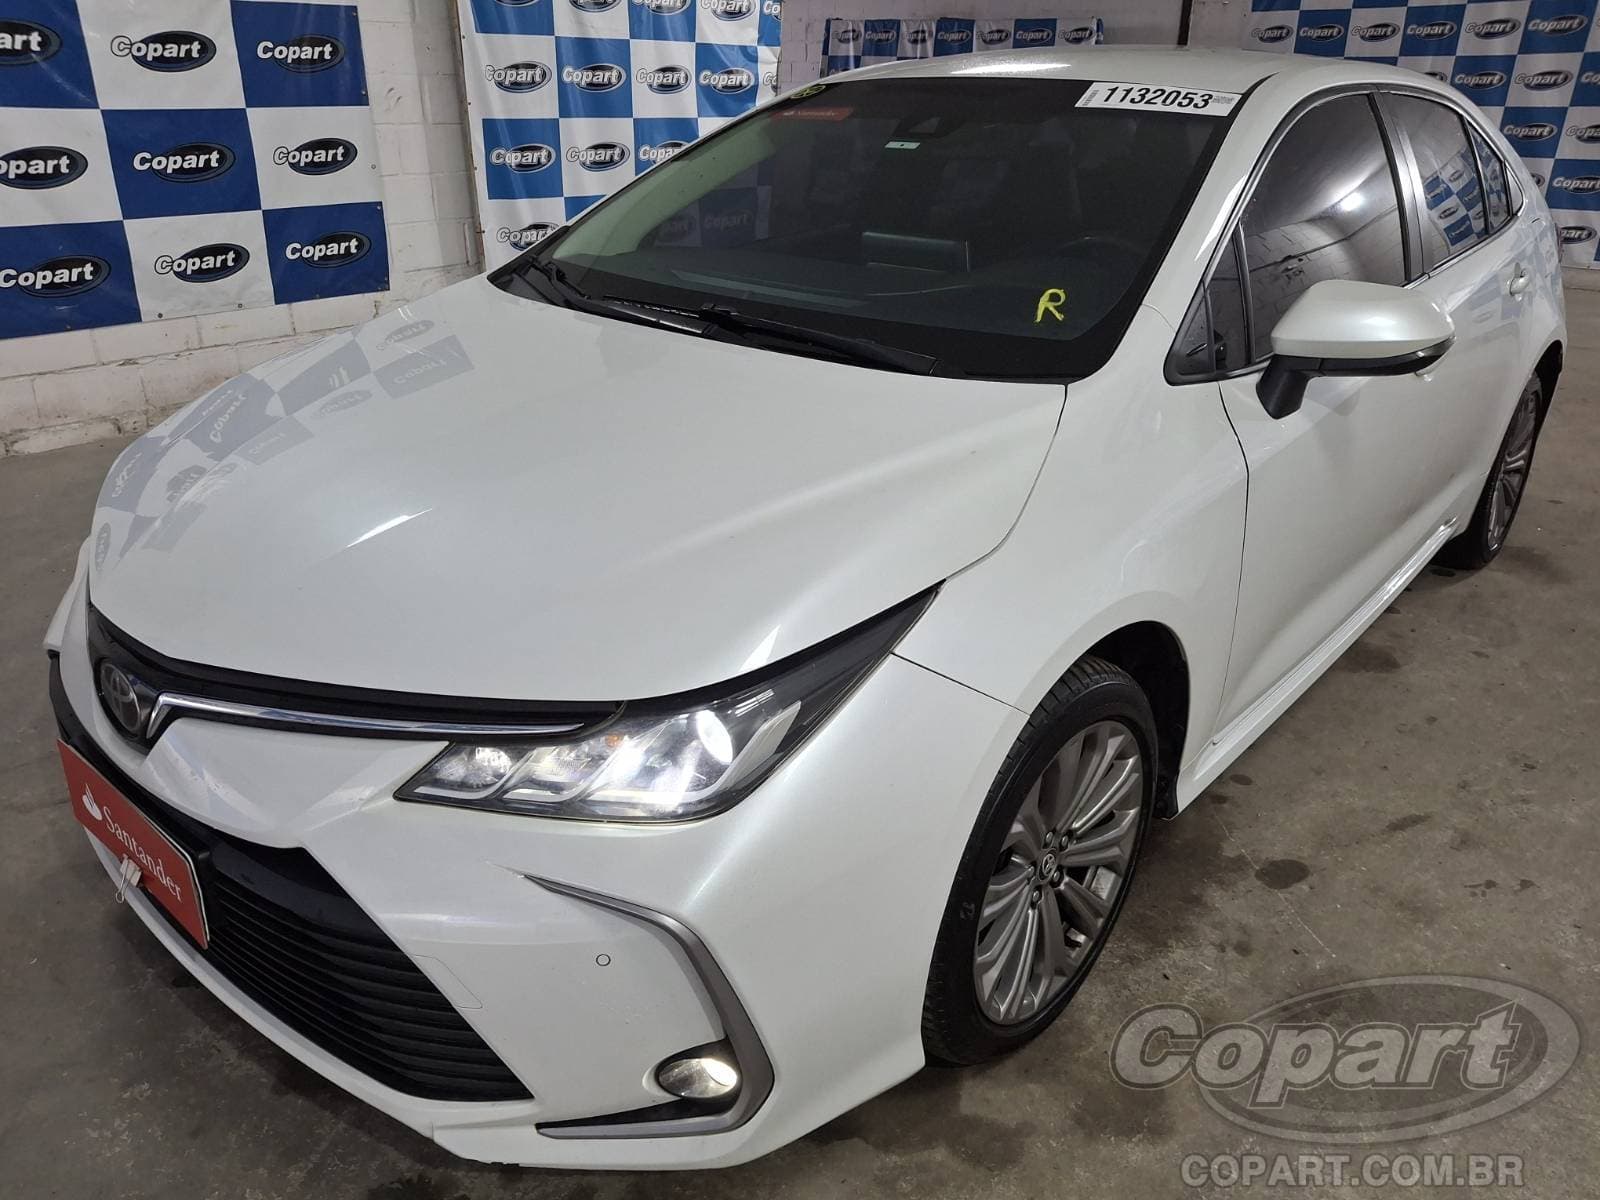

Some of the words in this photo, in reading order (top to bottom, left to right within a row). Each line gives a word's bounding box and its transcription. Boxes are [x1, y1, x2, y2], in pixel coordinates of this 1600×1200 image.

[1251, 27, 1288, 38] Copart
[1300, 26, 1339, 38] Copart
[1351, 25, 1394, 37] Copart
[1407, 24, 1450, 35] Copart
[1465, 22, 1512, 33] Copart
[1528, 18, 1580, 32] Copart
[1016, 30, 1049, 40] Copart
[111, 35, 201, 61] Copart
[257, 41, 333, 63] Copart
[485, 64, 544, 85] Copart
[562, 66, 622, 86] Copart
[636, 68, 687, 87] Copart
[700, 71, 748, 88] Copart
[1455, 73, 1500, 86] Copart
[1515, 72, 1564, 86] Copart
[1103, 87, 1213, 109] 1132053
[1503, 124, 1550, 137] Copart
[133, 150, 220, 173] Copart
[273, 145, 345, 166] Copart
[566, 146, 621, 163] Copart
[286, 237, 358, 261] Copart
[155, 250, 236, 275] Copart
[0, 262, 94, 289] Copart
[1034, 288, 1066, 323] R
[103, 805, 182, 902] Santander
